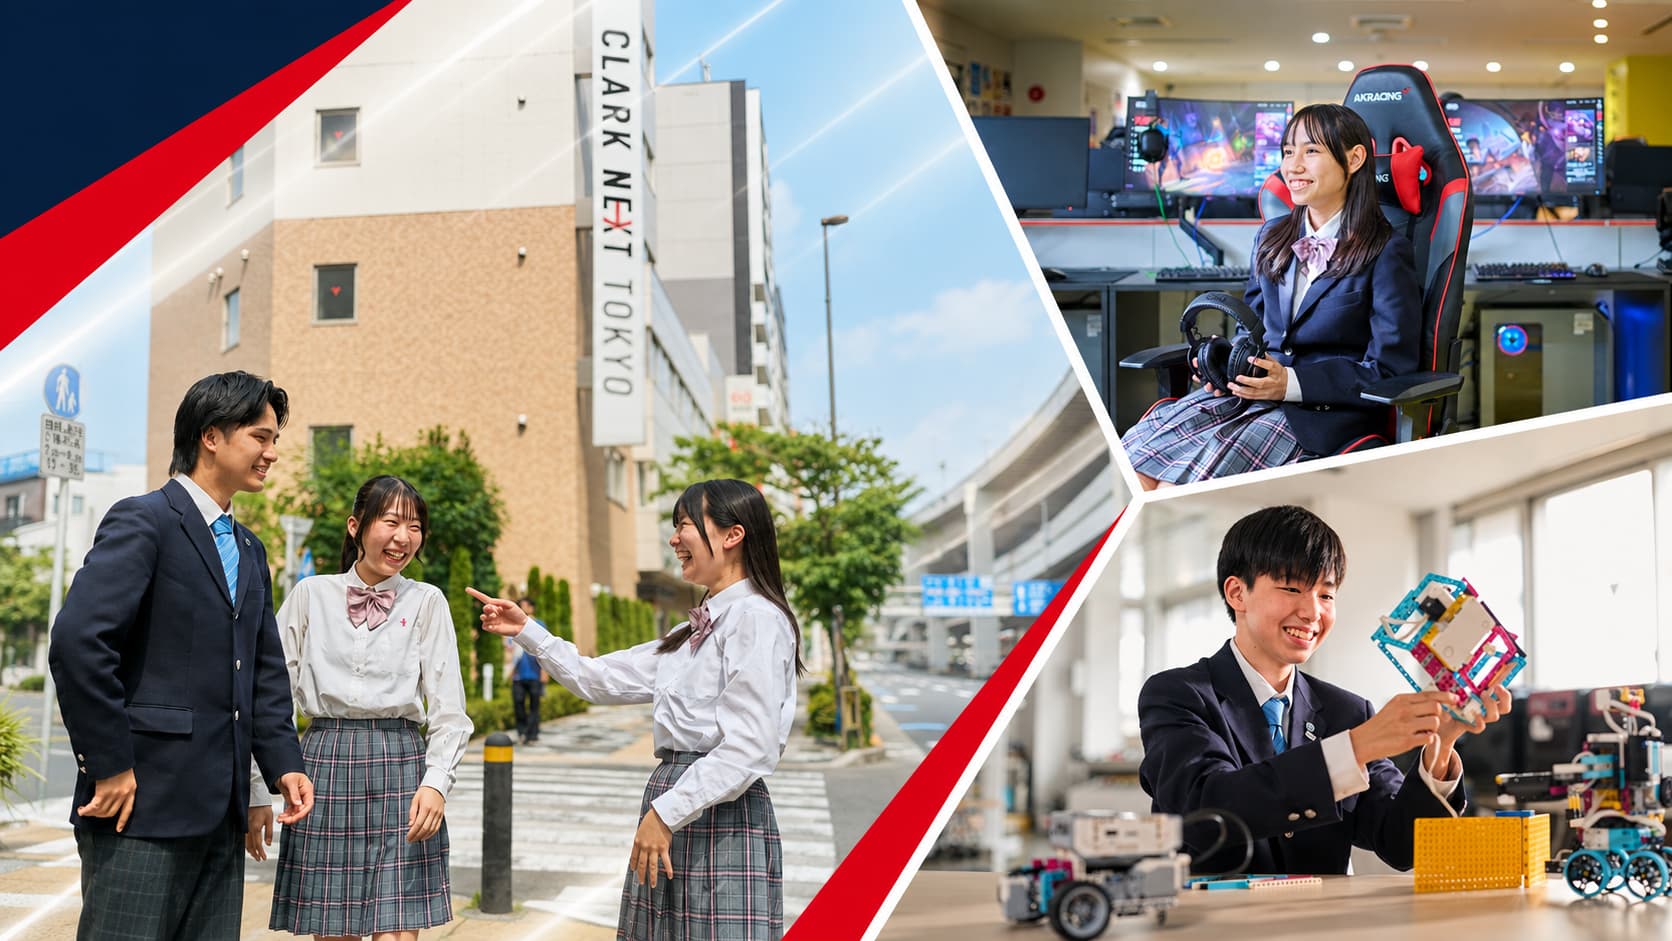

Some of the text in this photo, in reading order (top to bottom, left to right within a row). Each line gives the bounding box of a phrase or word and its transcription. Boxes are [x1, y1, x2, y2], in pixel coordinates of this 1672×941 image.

[602, 29, 632, 395] CLARK NEXT TOKYO
